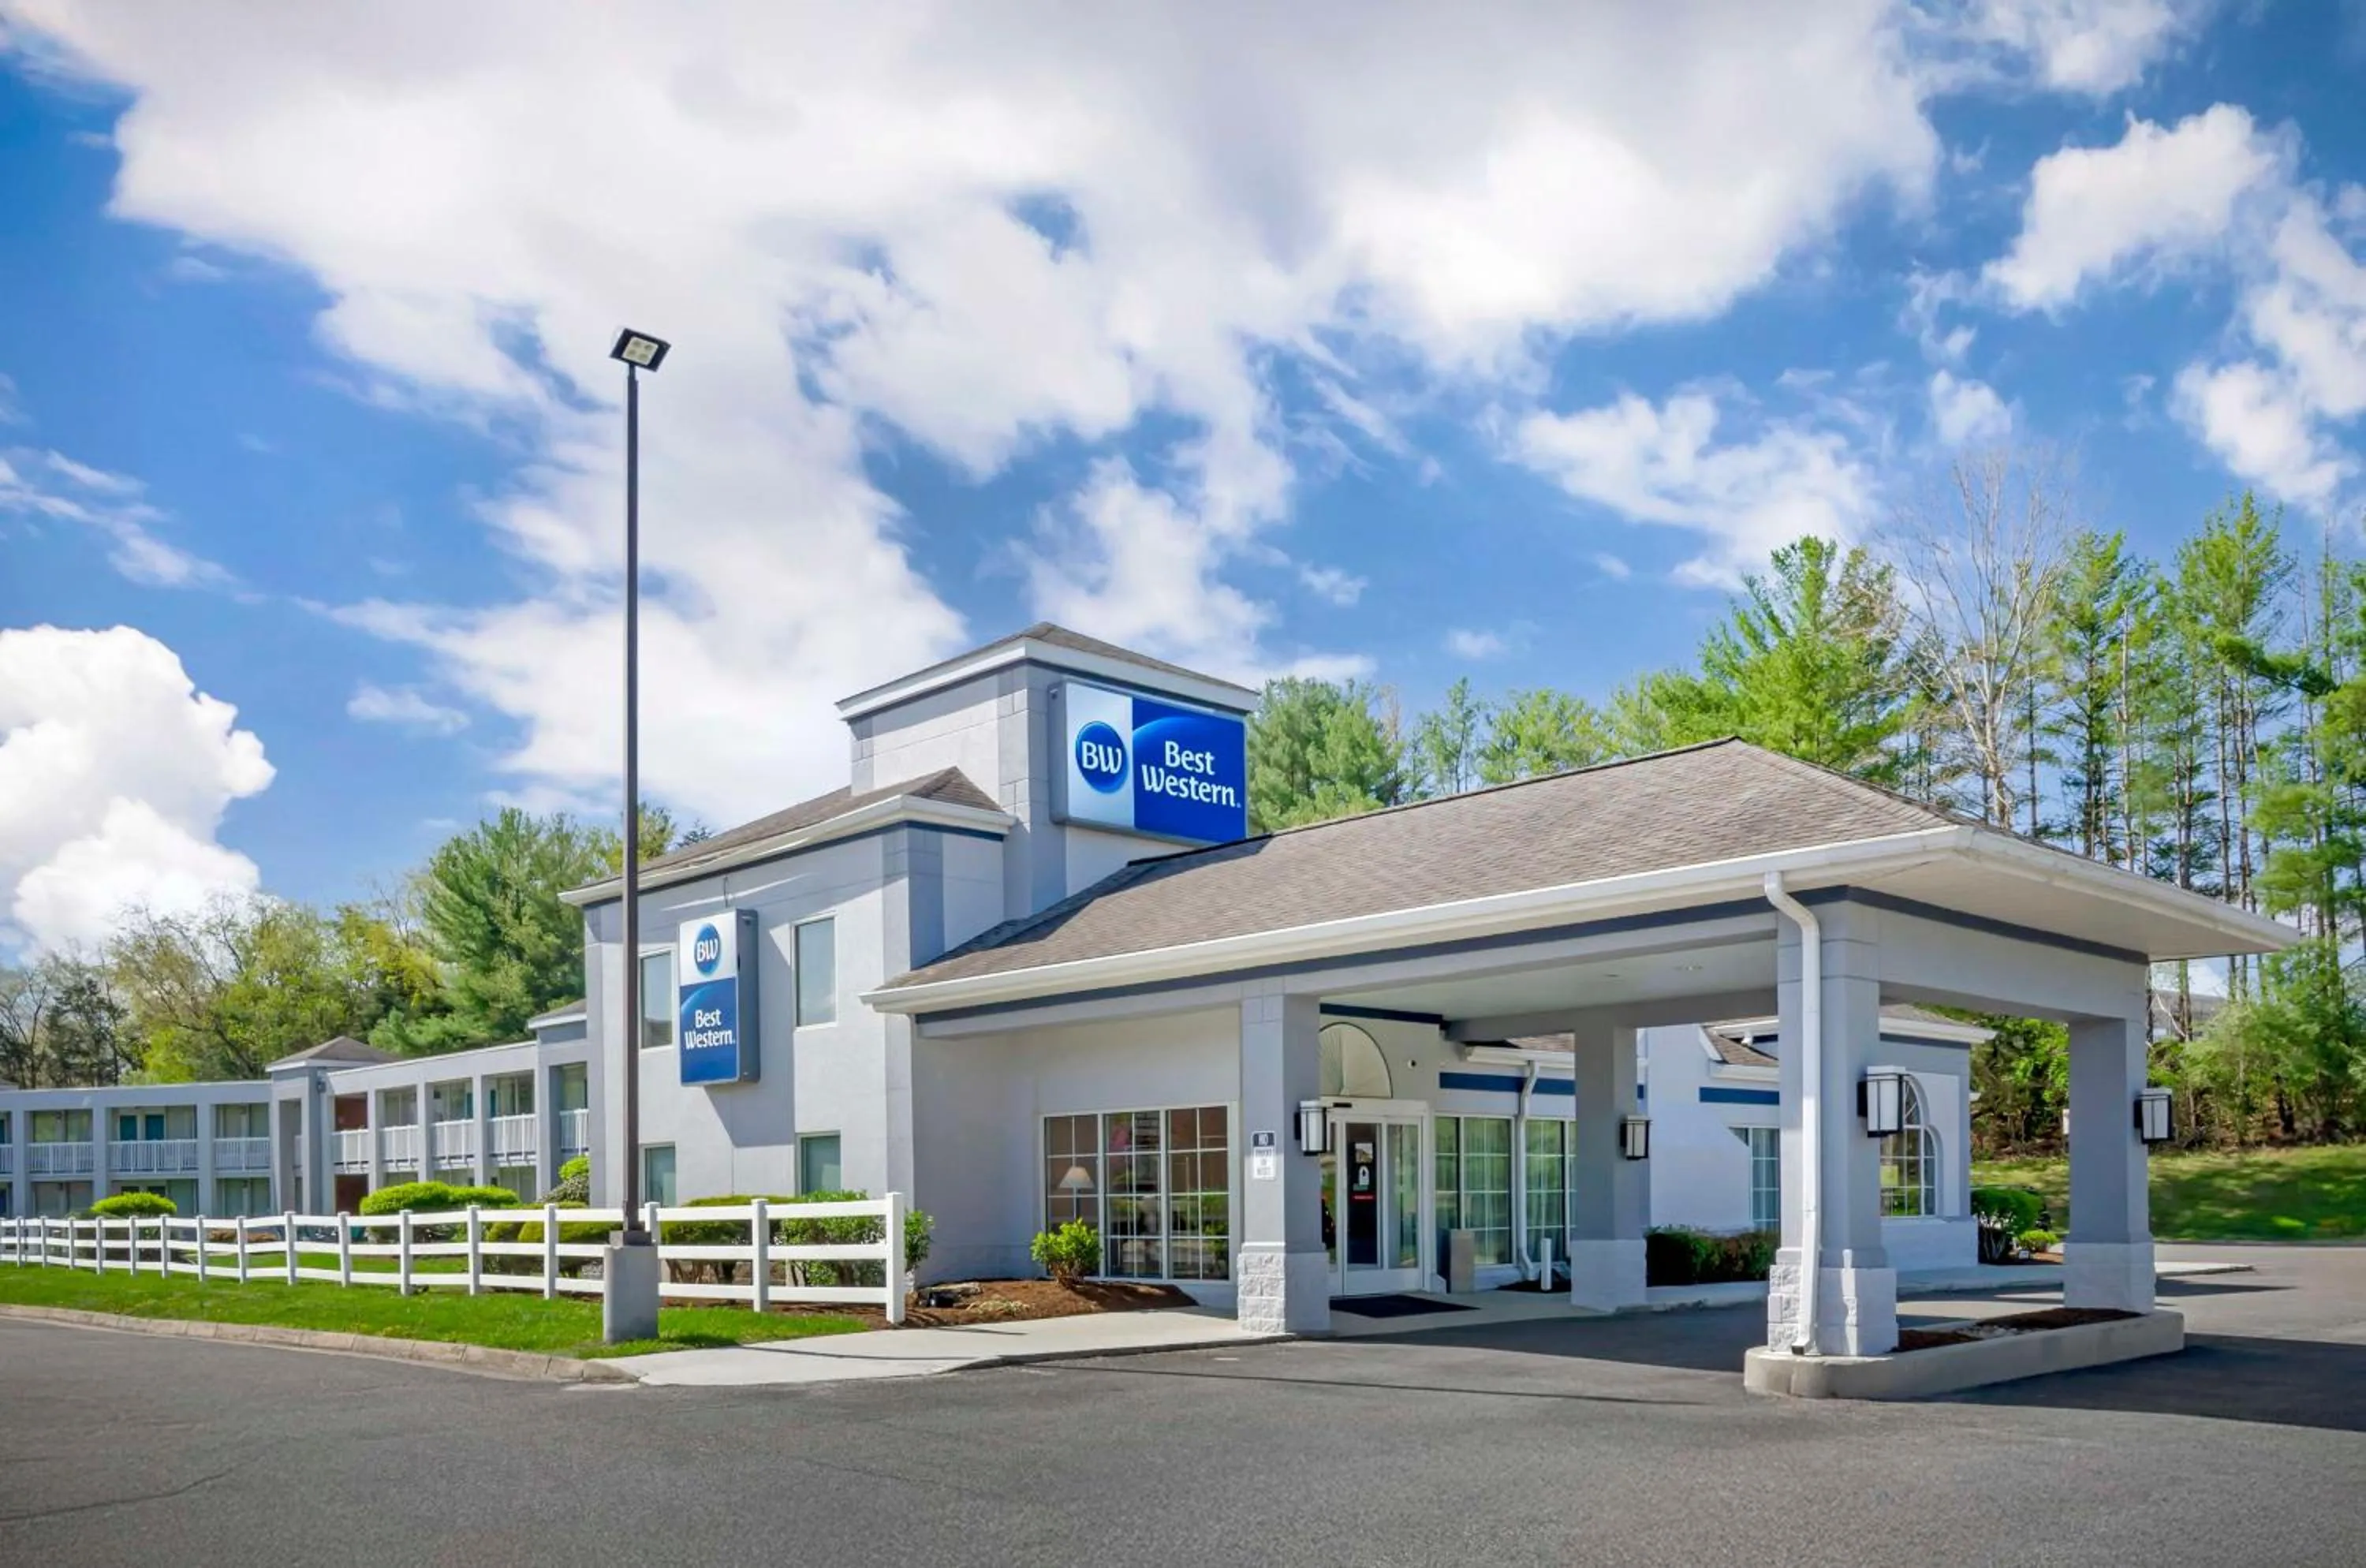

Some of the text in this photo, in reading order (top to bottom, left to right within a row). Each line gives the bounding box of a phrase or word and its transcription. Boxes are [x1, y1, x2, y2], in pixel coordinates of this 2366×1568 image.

[1081, 741, 1122, 774] BW
[1165, 740, 1215, 775] Best
[696, 939, 718, 961] BW
[695, 1009, 722, 1029] Best
